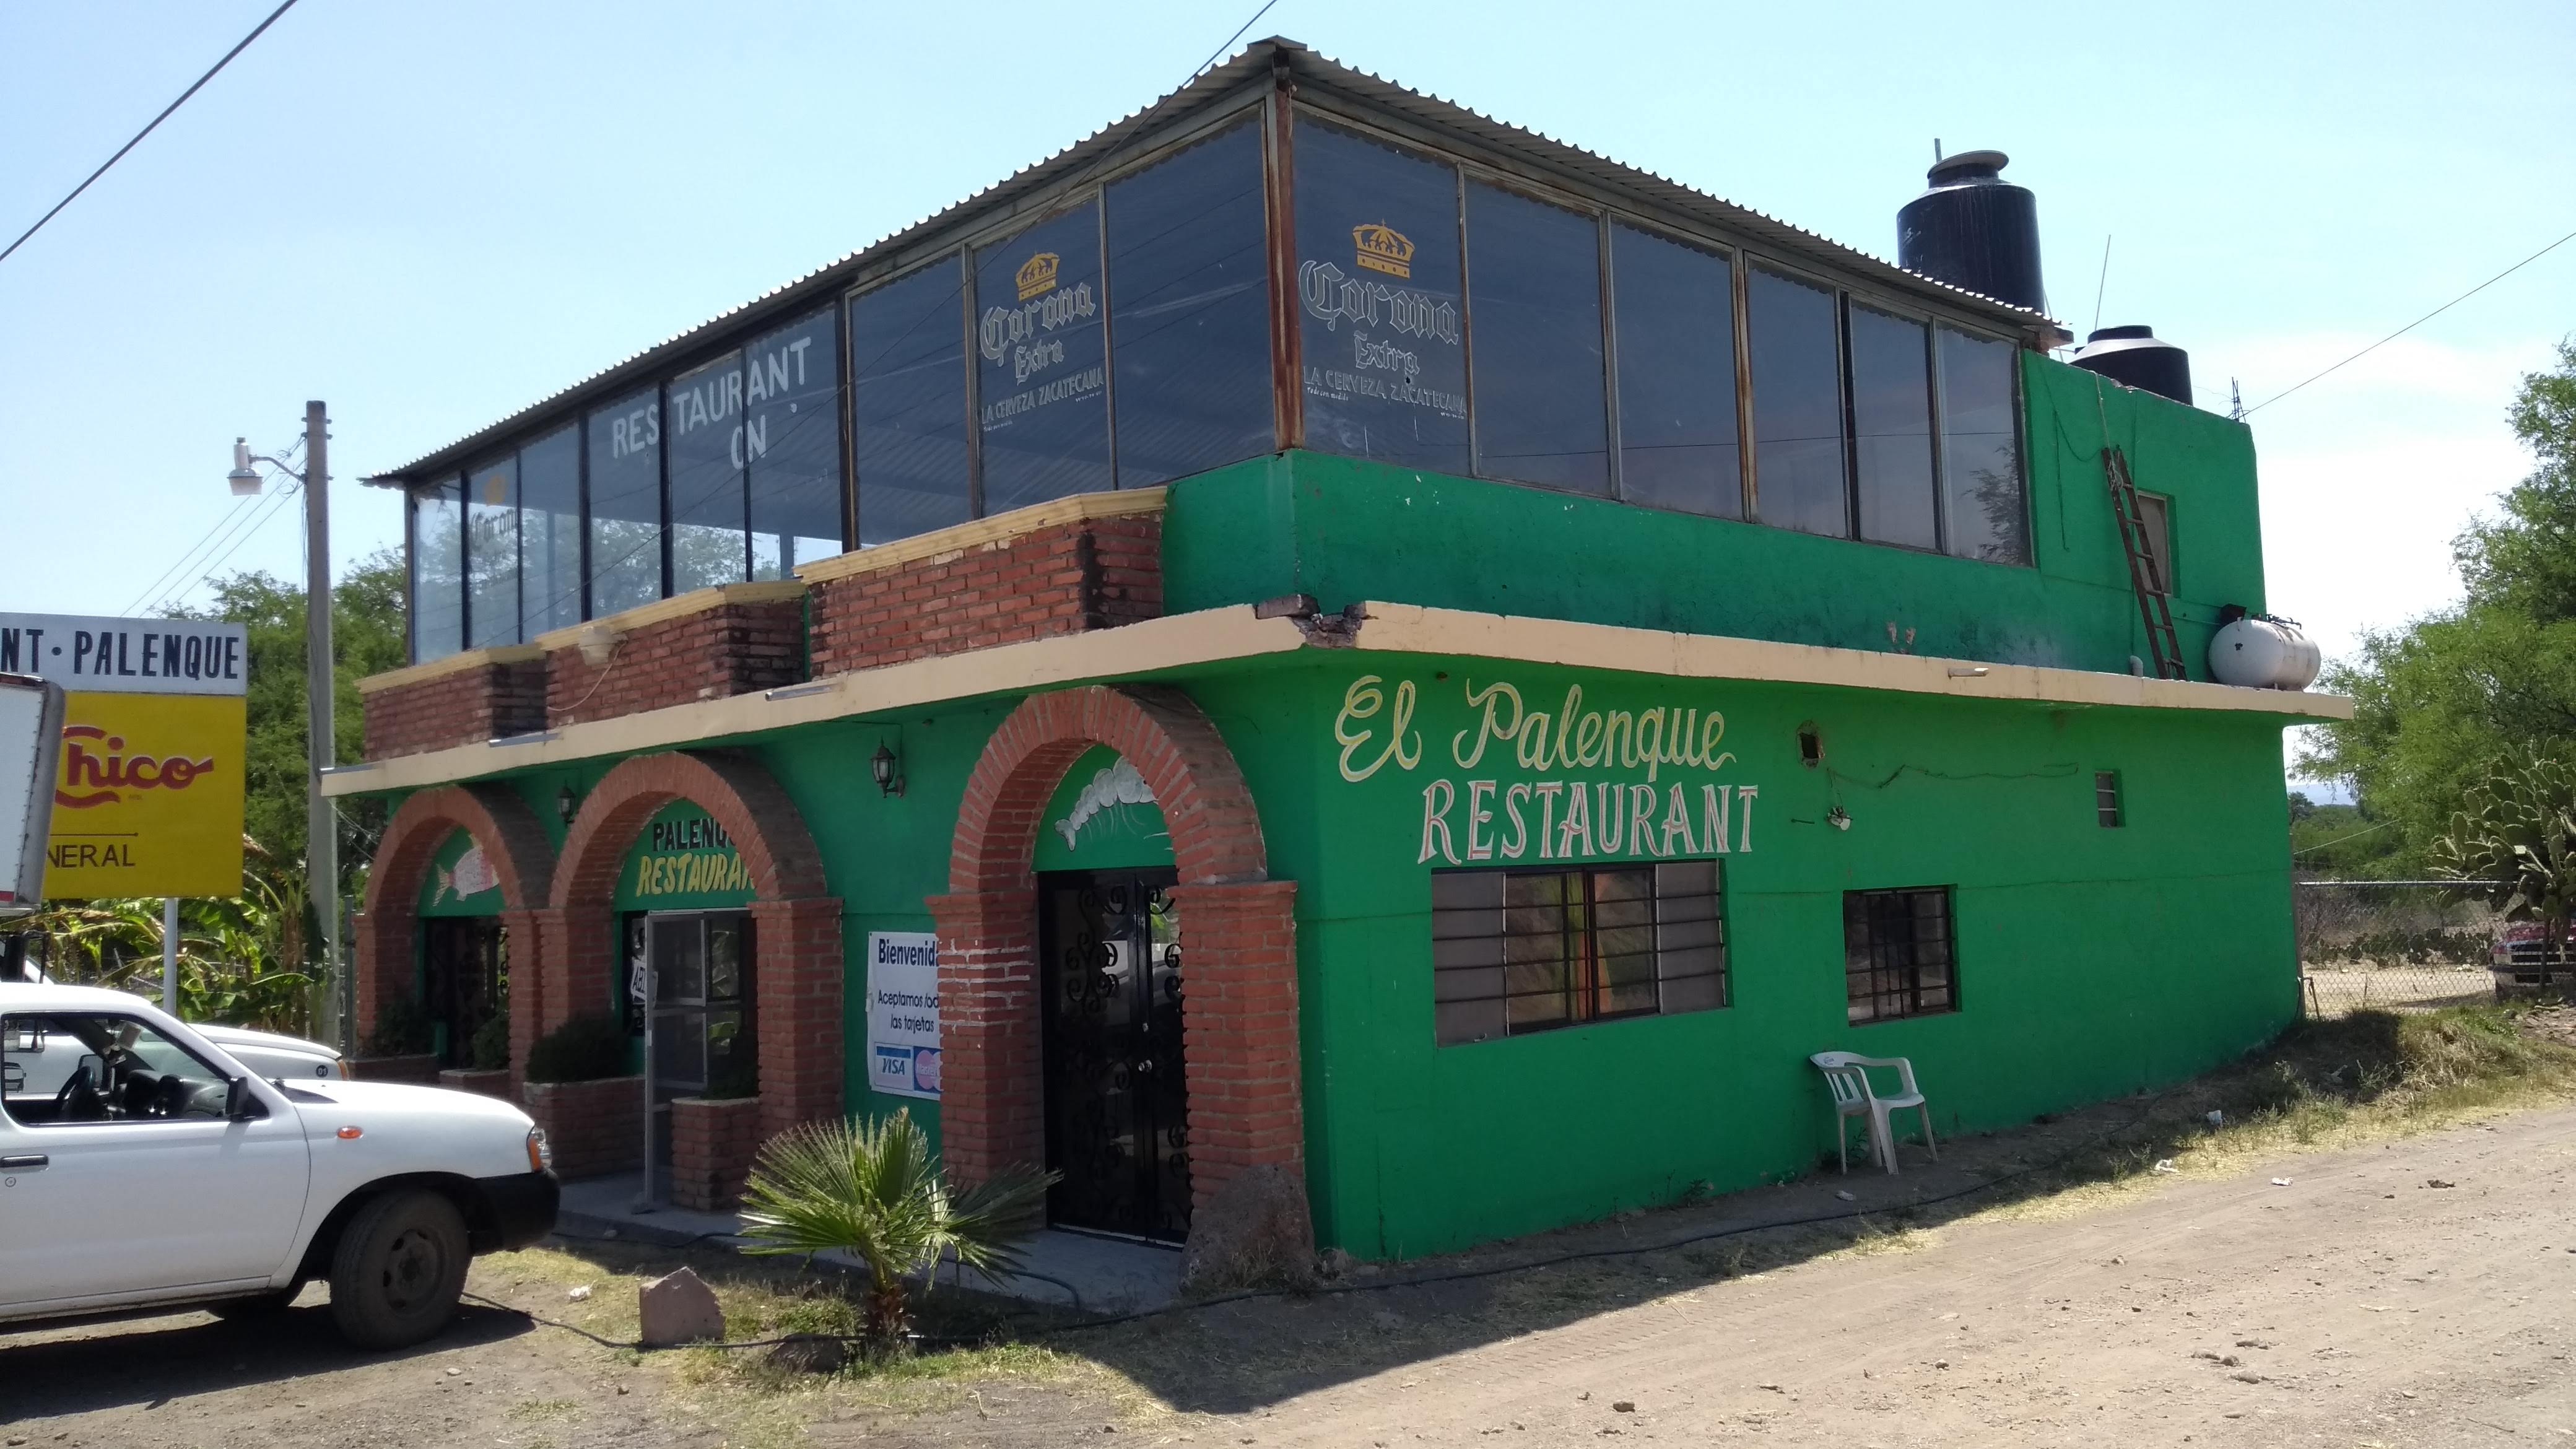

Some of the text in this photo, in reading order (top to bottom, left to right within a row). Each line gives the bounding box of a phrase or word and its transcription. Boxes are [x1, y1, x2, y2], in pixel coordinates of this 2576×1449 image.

[980, 282, 1097, 367] Corona
[1299, 260, 1459, 346] Corona
[1015, 339, 1064, 386] Extra
[1354, 330, 1421, 375] Extra
[982, 367, 1104, 425] LA CERVEZA ZACATECANA
[1303, 366, 1323, 387] LA
[1326, 369, 1387, 400] CERVEZA
[74, 630, 240, 681] PALENQUE
[1334, 676, 1737, 783] El Palenque
[653, 817, 736, 852] PALENQ
[1417, 778, 1759, 865] RESTAURANT
[878, 938, 939, 967] Bienvenid
[878, 990, 923, 1008] Aceptamos
[890, 1014, 934, 1034] las tarjetas
[882, 1058, 905, 1076] VISA
